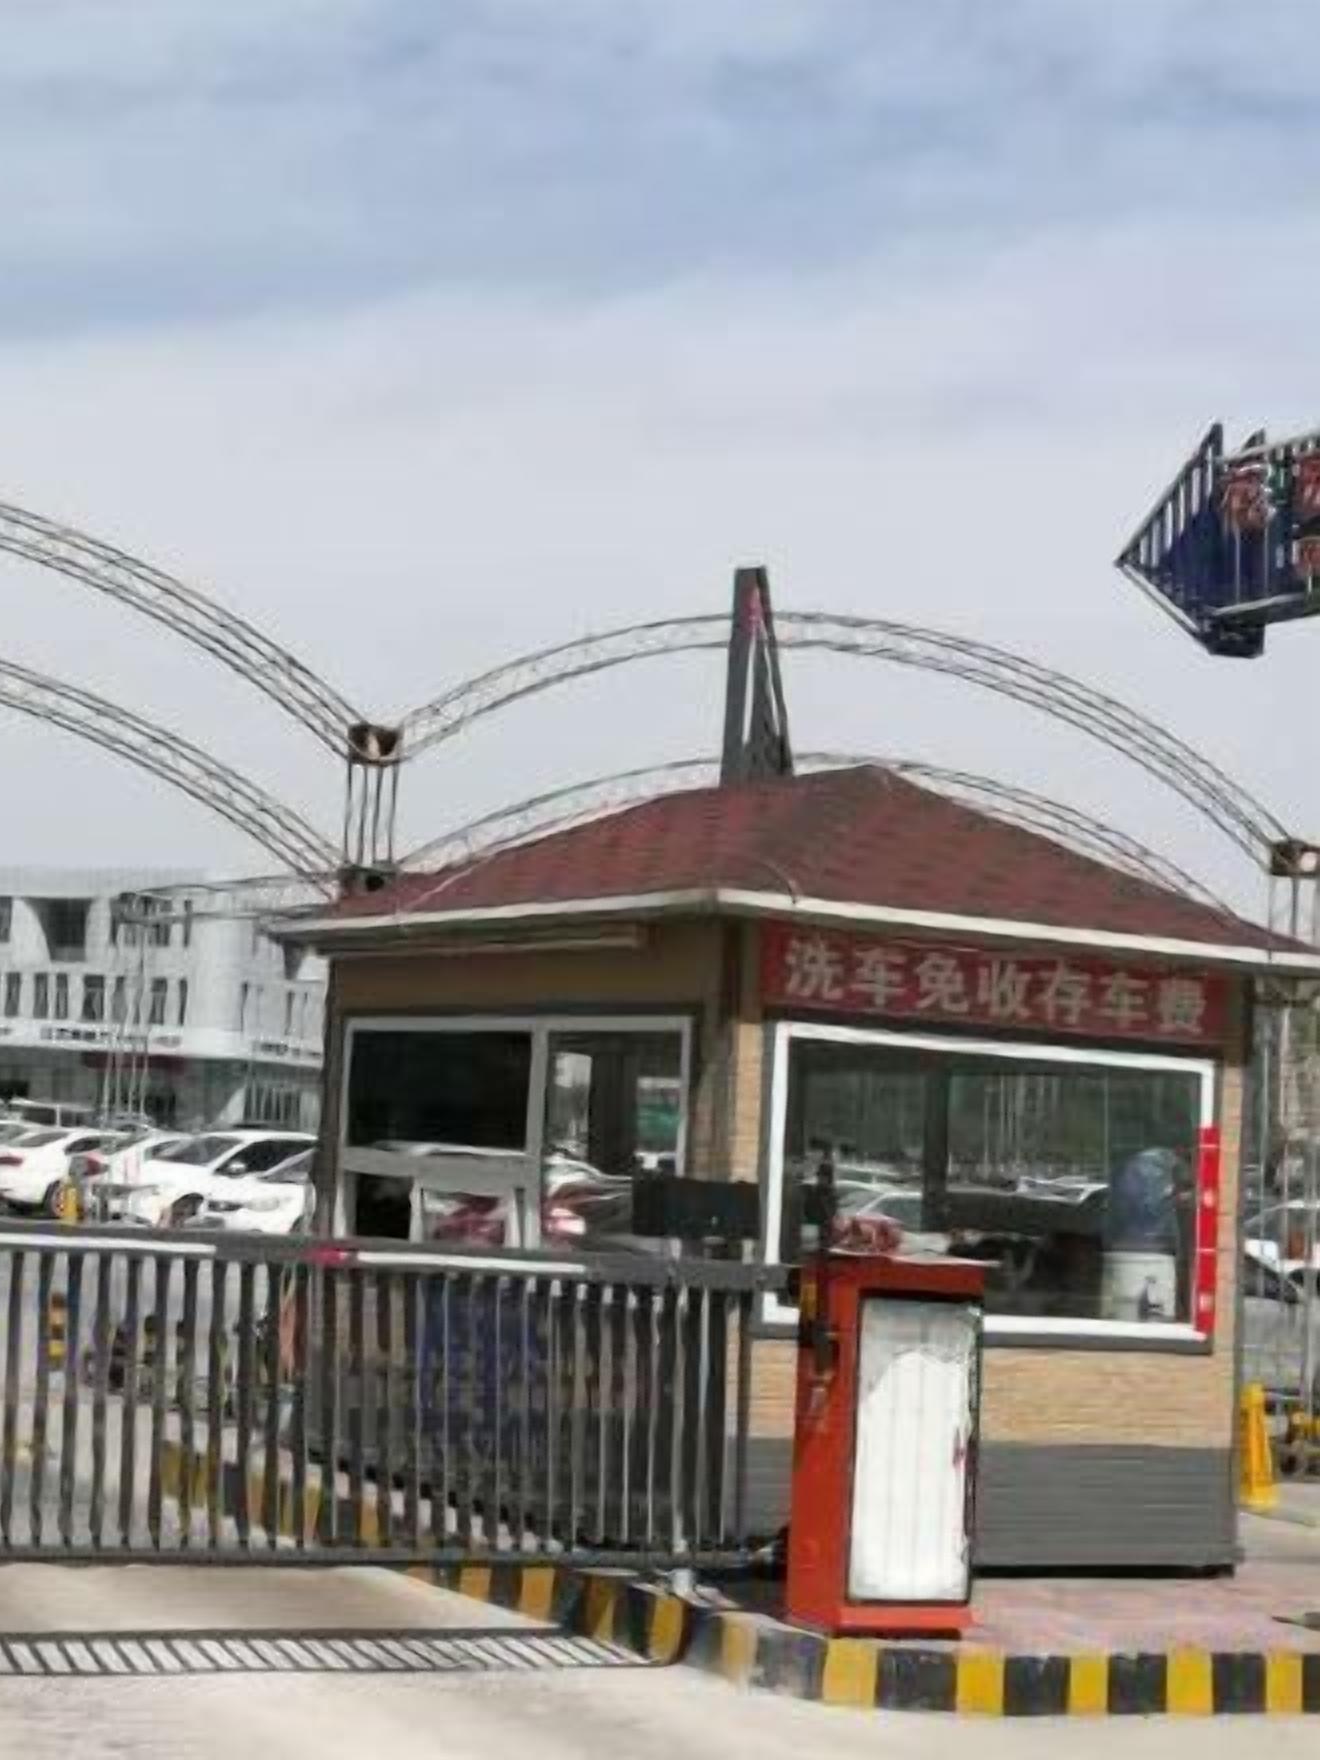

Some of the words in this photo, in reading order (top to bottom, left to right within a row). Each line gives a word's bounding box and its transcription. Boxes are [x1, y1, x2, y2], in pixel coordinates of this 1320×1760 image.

[784, 933, 1208, 1034] 洗车免收存车费
